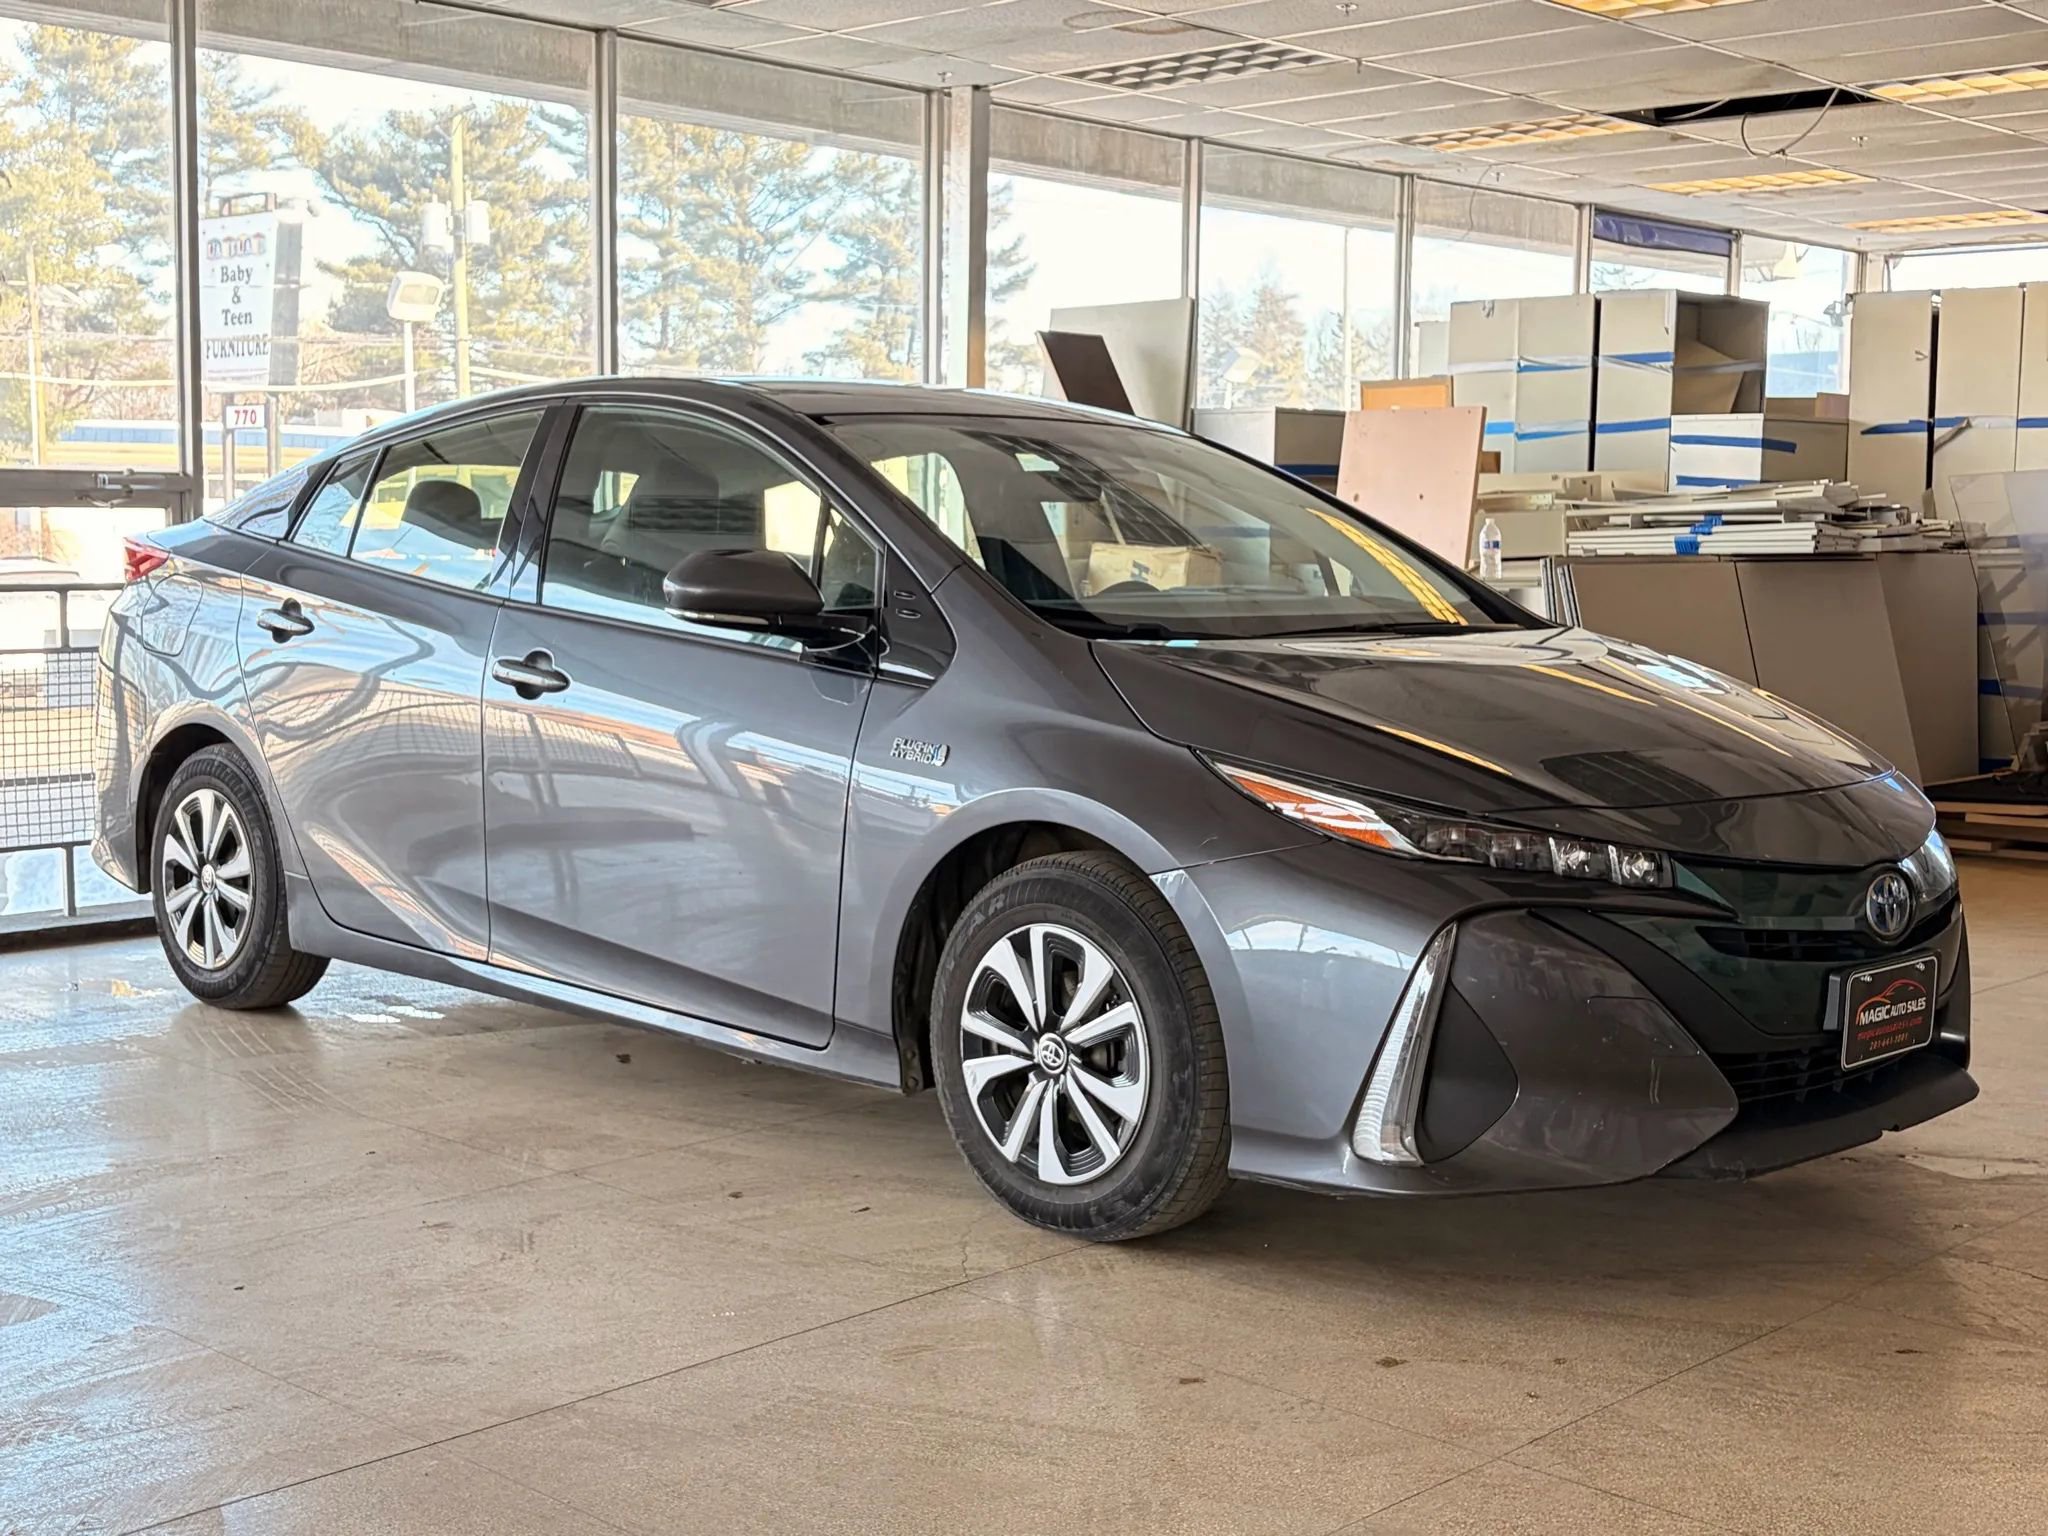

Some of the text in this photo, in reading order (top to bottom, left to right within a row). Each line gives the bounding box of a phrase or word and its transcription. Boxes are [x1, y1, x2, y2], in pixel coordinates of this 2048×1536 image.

[220, 264, 253, 285] Baby
[231, 285, 242, 305] &
[221, 308, 253, 326] Teen
[206, 333, 269, 360] FURNITURE
[234, 409, 257, 425] 770
[893, 737, 935, 754] PLUG-IN
[890, 747, 932, 764] HYBRID
[1859, 997, 1926, 1026] MAGIC AUTO SALES
